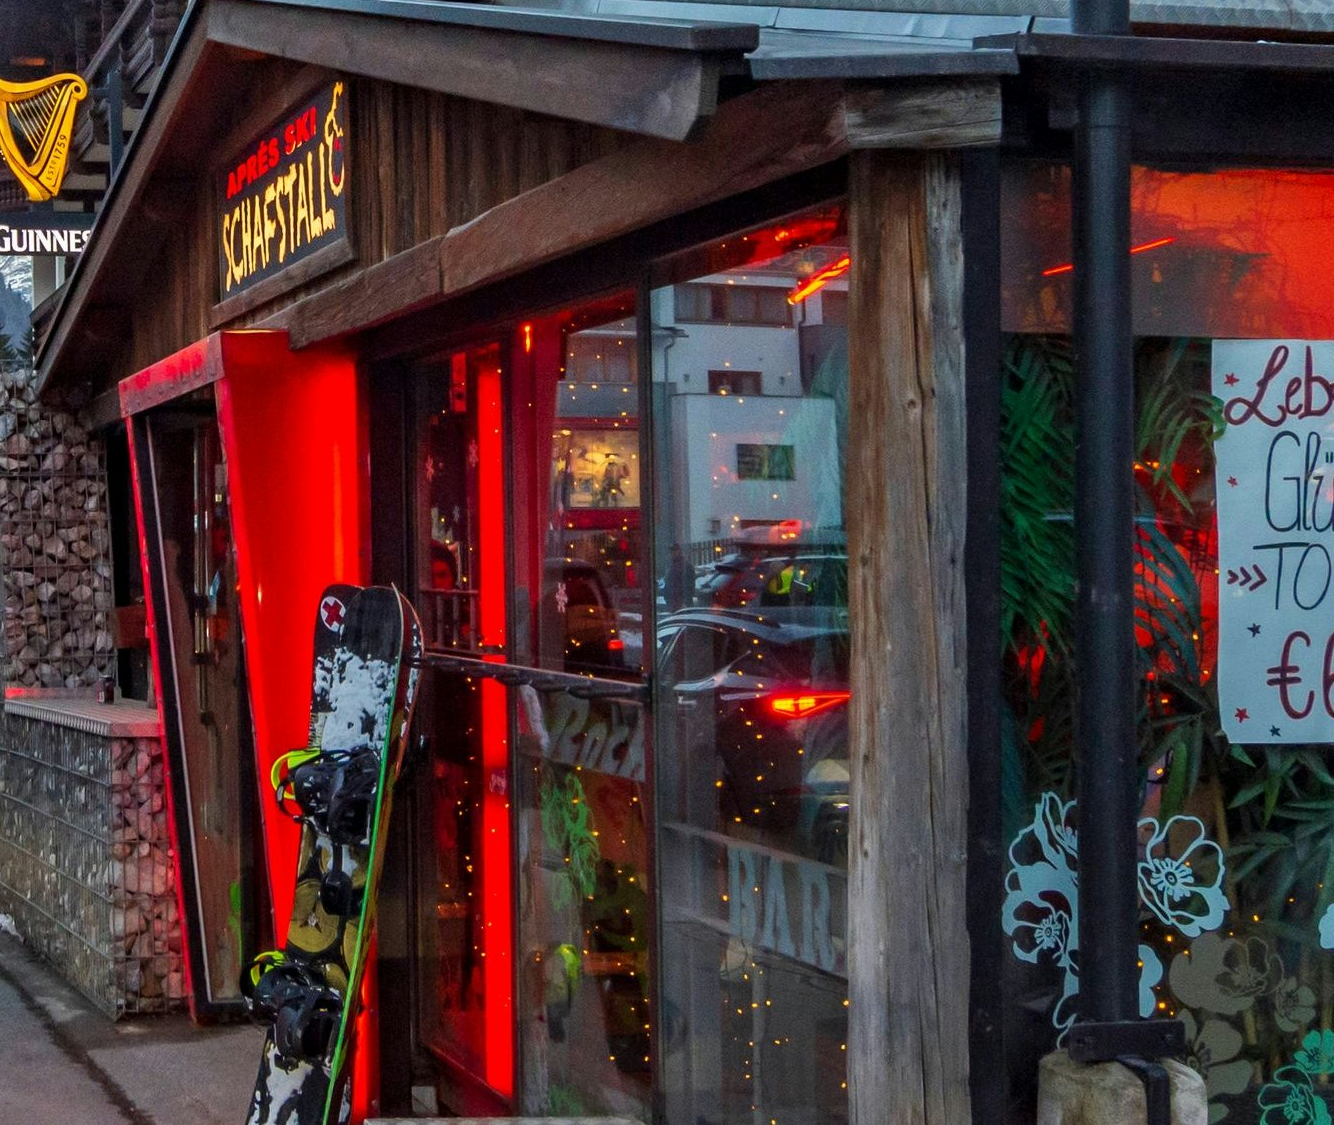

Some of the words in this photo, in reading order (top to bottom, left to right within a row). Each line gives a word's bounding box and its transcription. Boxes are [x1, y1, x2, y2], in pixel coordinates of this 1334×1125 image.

[226, 139, 280, 201] APRÉS
[284, 106, 317, 155] SKI
[222, 141, 336, 292] SCHAFSTALL
[1252, 542, 1332, 611] TO
[727, 846, 836, 972] BAR
